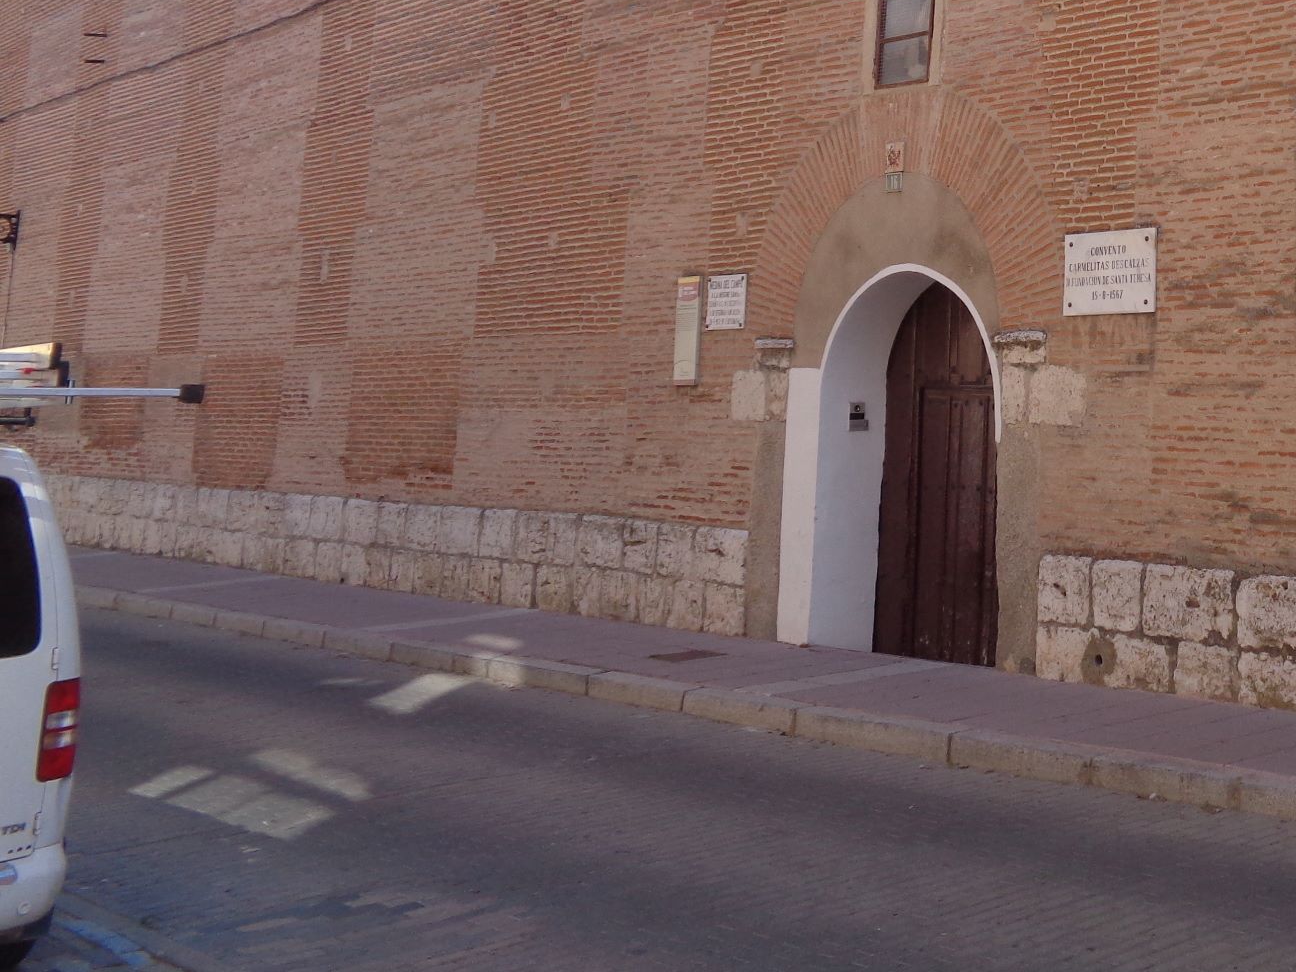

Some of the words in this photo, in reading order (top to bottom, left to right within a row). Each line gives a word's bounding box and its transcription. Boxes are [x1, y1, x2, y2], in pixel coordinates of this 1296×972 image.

[1090, 245, 1127, 256] CONVENTO
[1069, 261, 1109, 273] CARMELITAS
[1111, 257, 1150, 269] DESCALZAS
[1102, 275, 1109, 285] DE
[1110, 274, 1128, 285] SANTA
[1129, 273, 1151, 283] TERESA
[2, 823, 27, 835] TDI
